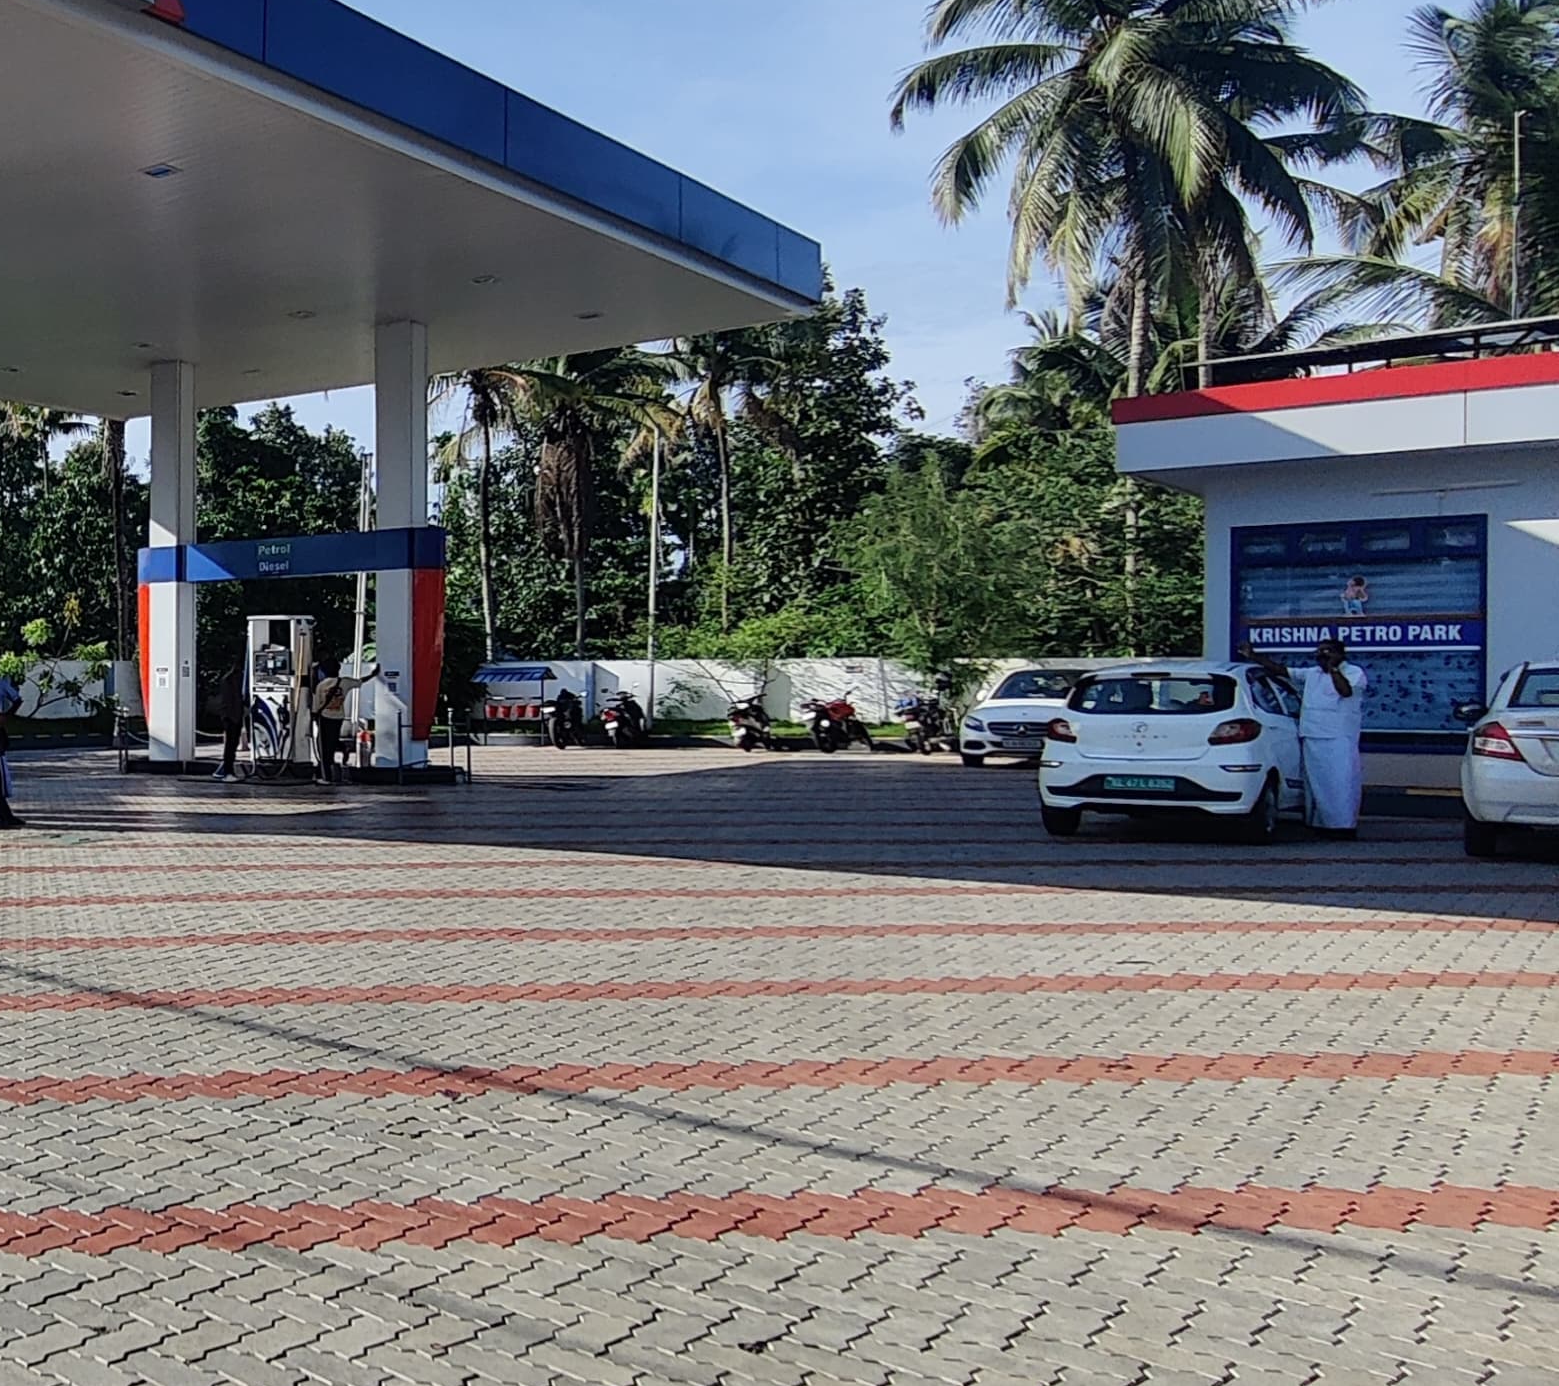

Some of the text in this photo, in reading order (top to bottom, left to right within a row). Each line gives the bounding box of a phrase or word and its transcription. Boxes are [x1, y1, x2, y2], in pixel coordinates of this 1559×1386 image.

[258, 543, 291, 556] Petrol
[258, 560, 289, 572] Diesel
[1249, 624, 1462, 643] KRISHNA PETRO PARK
